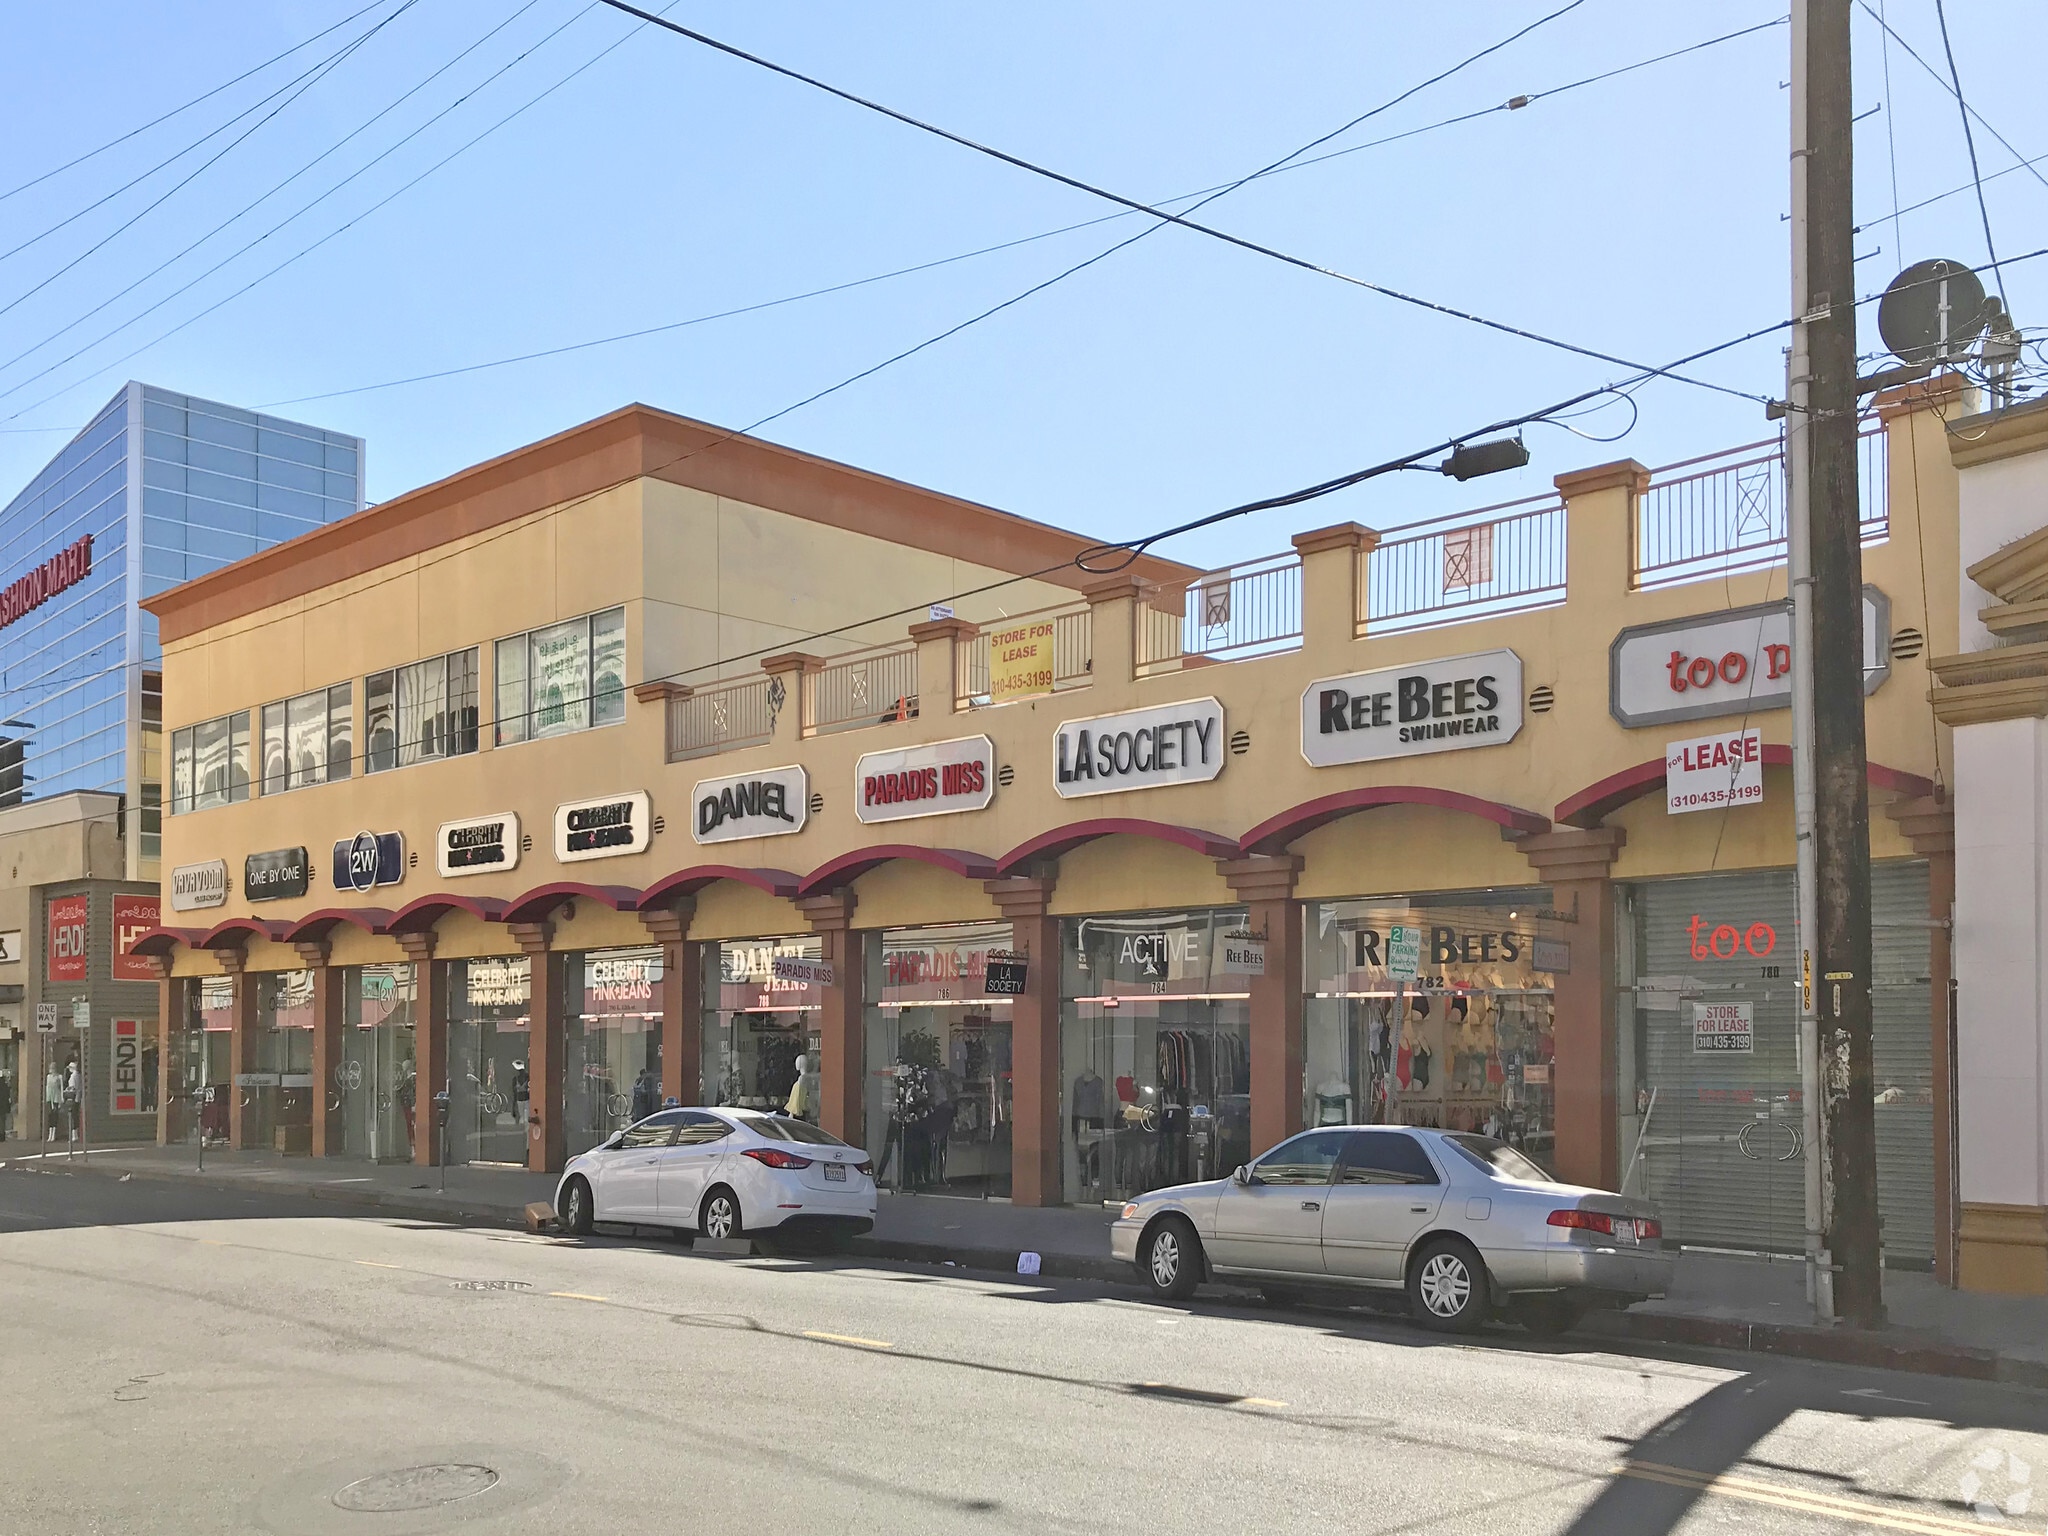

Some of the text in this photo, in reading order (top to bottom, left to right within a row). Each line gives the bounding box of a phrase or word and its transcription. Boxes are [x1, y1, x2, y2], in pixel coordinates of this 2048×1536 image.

[47, 534, 94, 597] MART
[991, 623, 1053, 648] STORE FOR
[1002, 645, 1037, 663] LEASE
[1666, 650, 1748, 693] too
[991, 670, 1053, 696] 310-435-3199
[1399, 715, 1500, 743] SWIMWEAR
[1058, 716, 1216, 783] LA SOCIETY
[1683, 736, 1759, 772] LEASE
[1667, 754, 1684, 769] FOR
[865, 760, 985, 806] PARADIS MISS
[699, 781, 795, 835] DANIEL
[351, 849, 375, 873] 2W
[250, 865, 300, 886] ONE BY ONE
[1393, 927, 1401, 941] 2
[1686, 913, 1776, 962] too
[1120, 933, 1199, 964] ACTIVE
[1391, 943, 1418, 957] PARKING
[473, 967, 524, 988] CELEBRITY
[593, 959, 651, 981] CELEBRITY
[775, 961, 832, 983] PARADIS MISS
[889, 951, 961, 983] PARADIS
[1000, 967, 1011, 980] LA
[593, 980, 652, 1001] PINK JEANS
[987, 980, 1023, 993] SOCIETY
[1151, 982, 1166, 993] 784
[1417, 976, 1444, 988] 782
[938, 988, 950, 999] 786
[38, 1005, 55, 1013] ONE
[1706, 1006, 1739, 1019] STORE
[1696, 1019, 1750, 1032] FOR LEASE
[116, 1037, 136, 1093] HENDI
